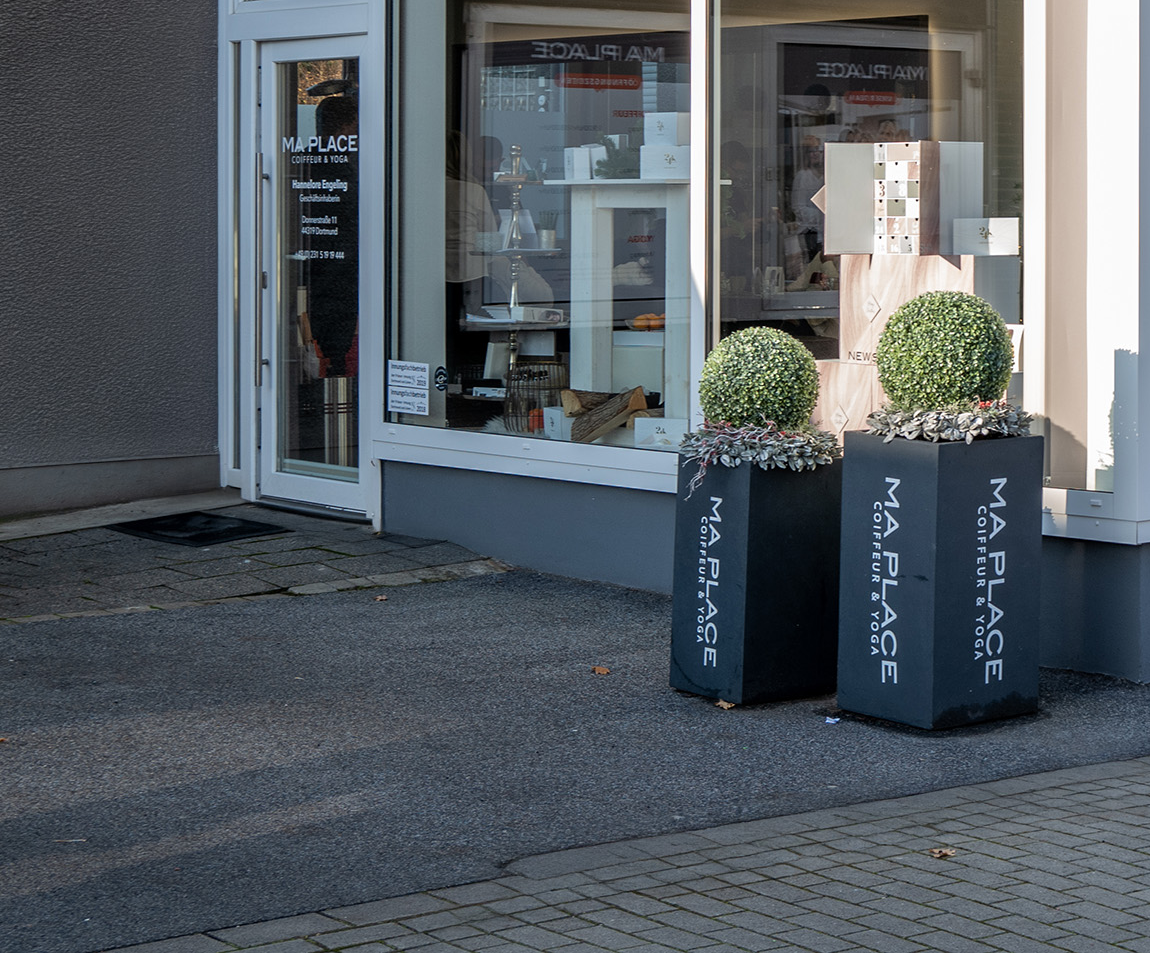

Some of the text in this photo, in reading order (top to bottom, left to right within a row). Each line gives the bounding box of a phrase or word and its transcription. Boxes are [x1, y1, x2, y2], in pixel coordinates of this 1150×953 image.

[282, 134, 358, 153] MA PLACE
[291, 154, 348, 164] COIFFEUR & YOGA
[696, 516, 708, 643] COIFFEUR & YOGA
[703, 496, 723, 668] MA PLACE
[870, 501, 882, 656] COIFFEUR & YOGA
[881, 476, 901, 684] MA PLACE
[974, 505, 986, 660] COIFFEUR & YOGA
[985, 477, 1007, 684] MA PLACE
